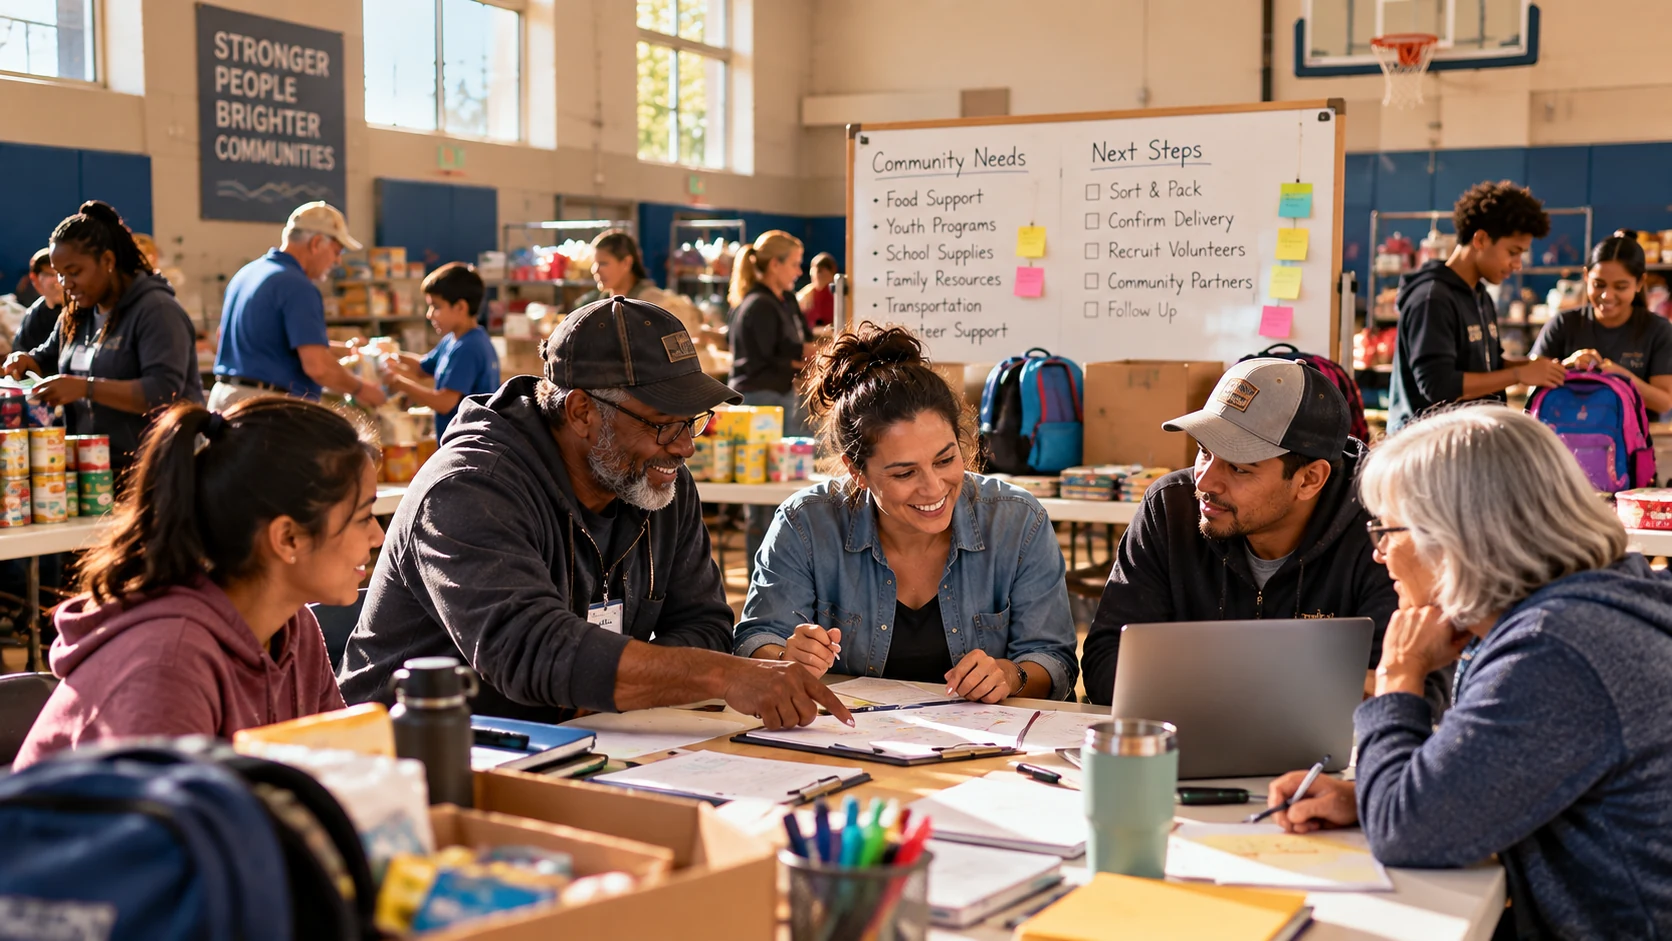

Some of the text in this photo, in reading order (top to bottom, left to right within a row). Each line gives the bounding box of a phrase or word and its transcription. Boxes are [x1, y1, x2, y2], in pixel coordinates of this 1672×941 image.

[214, 30, 330, 78] STRONGER
[215, 64, 298, 104] PEOPLE
[216, 99, 321, 139] BRIGHTER
[215, 134, 336, 171] COMMUNITIES
[872, 145, 1027, 178] Community Needs
[1092, 138, 1203, 168] Next Steps
[886, 188, 985, 212] Food Support
[1109, 179, 1203, 201] Sort & Pack
[886, 217, 925, 235] Youth
[932, 216, 997, 239] Programs
[1108, 209, 1235, 234] Confirm Delivery
[886, 243, 994, 267] School Supplies
[1108, 239, 1246, 259] Recruit Volunteers
[886, 270, 928, 294] Family
[935, 269, 1002, 287] Resources
[1107, 271, 1185, 296] Community
[1191, 270, 1253, 290] Partners
[885, 296, 982, 319] Transportation
[1108, 300, 1178, 325] Follow Up
[954, 321, 1009, 346] Support
